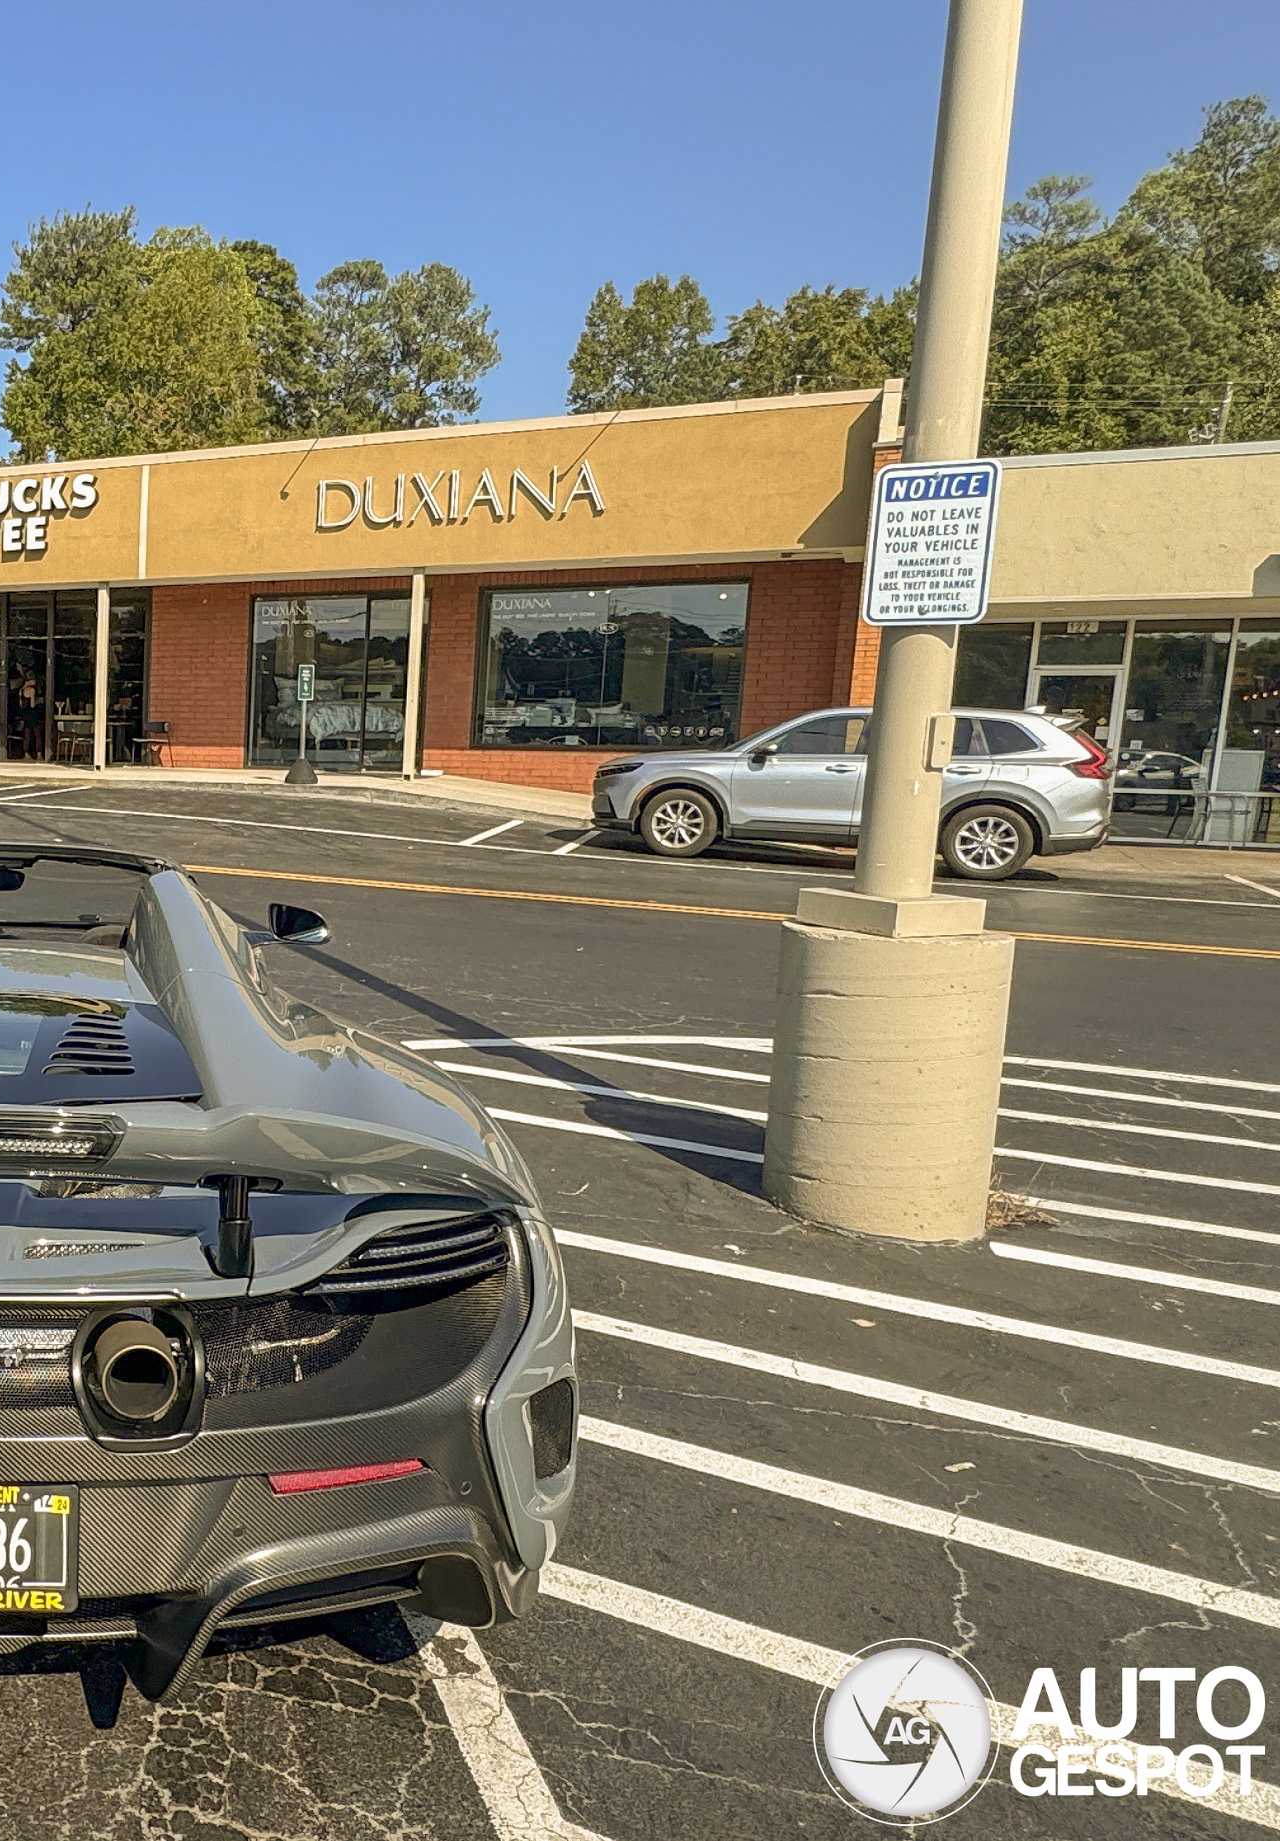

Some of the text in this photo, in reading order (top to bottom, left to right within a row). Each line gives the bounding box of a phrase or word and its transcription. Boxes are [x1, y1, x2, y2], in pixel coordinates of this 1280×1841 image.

[317, 459, 606, 527] DUXIANA
[891, 475, 985, 500] NOTICE
[887, 507, 982, 523] DO NOT LEAVE
[886, 523, 979, 538] VALUABLES IN
[884, 538, 979, 554] YOUR VEHICLE
[897, 556, 961, 567] MANAGEMENT IS
[883, 567, 973, 579] NOT RESPONSIBLE FOR
[903, 581, 927, 590] THEFT
[929, 580, 940, 589] OR
[943, 579, 976, 589] DAMAGE
[891, 592, 961, 602] TO YOUR VEHICLE
[492, 598, 552, 610] DUXIANA
[879, 605, 890, 614] OR
[893, 604, 914, 613] YOUR
[261, 605, 312, 617] DUXIANA
